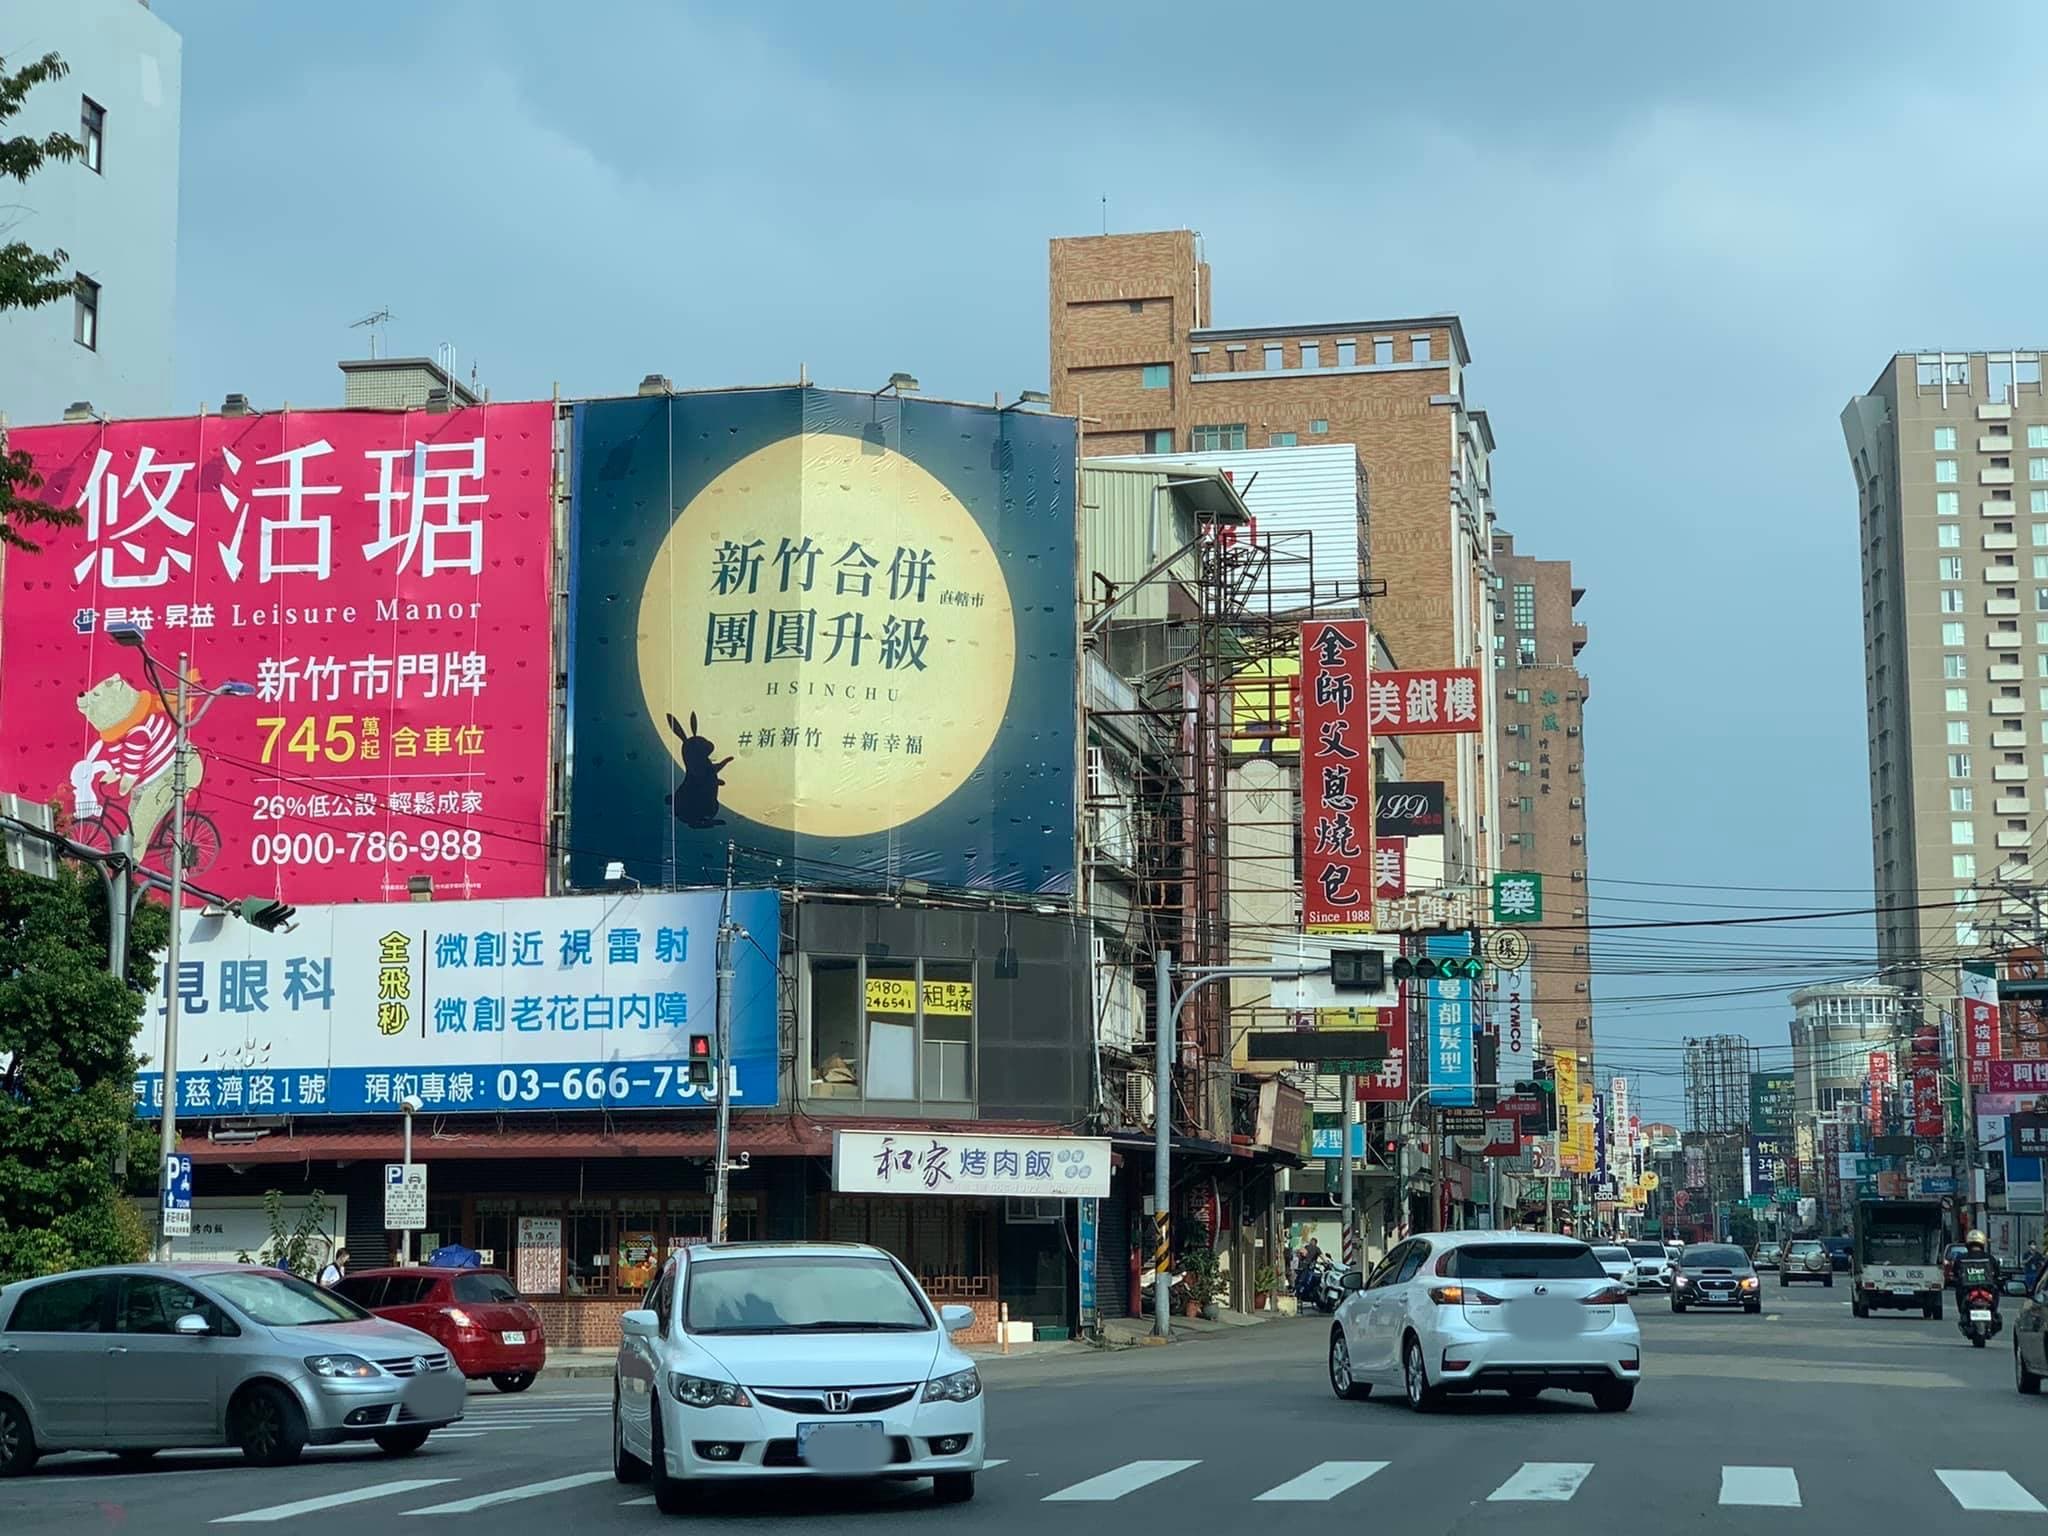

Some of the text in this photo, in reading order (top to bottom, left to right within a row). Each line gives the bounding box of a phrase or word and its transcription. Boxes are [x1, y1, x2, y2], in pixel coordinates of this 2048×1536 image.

[74, 437, 489, 588] 悠活琚
[709, 537, 936, 603] 新竹合併
[232, 598, 482, 627] Leisure Manor
[939, 589, 985, 608] 直轄市
[704, 607, 930, 672] 團圓升級
[256, 653, 488, 703] 新竹市門牌
[766, 680, 901, 703] HSINCHU
[256, 714, 355, 764] 745
[392, 725, 486, 757] 含車位
[738, 727, 923, 755] #新新竹 #新幸福
[251, 829, 482, 866] 0900-786-988
[1500, 878, 1535, 914] 藥
[1309, 910, 1370, 923] Since 1988
[434, 926, 689, 968] 微創近視雷射
[378, 931, 410, 1035] 全飛秒
[1509, 992, 1521, 1052] KYMCO
[168, 1157, 180, 1190] P
[389, 1167, 402, 1183] P
[960, 1148, 1052, 1177] 烤肉飯
